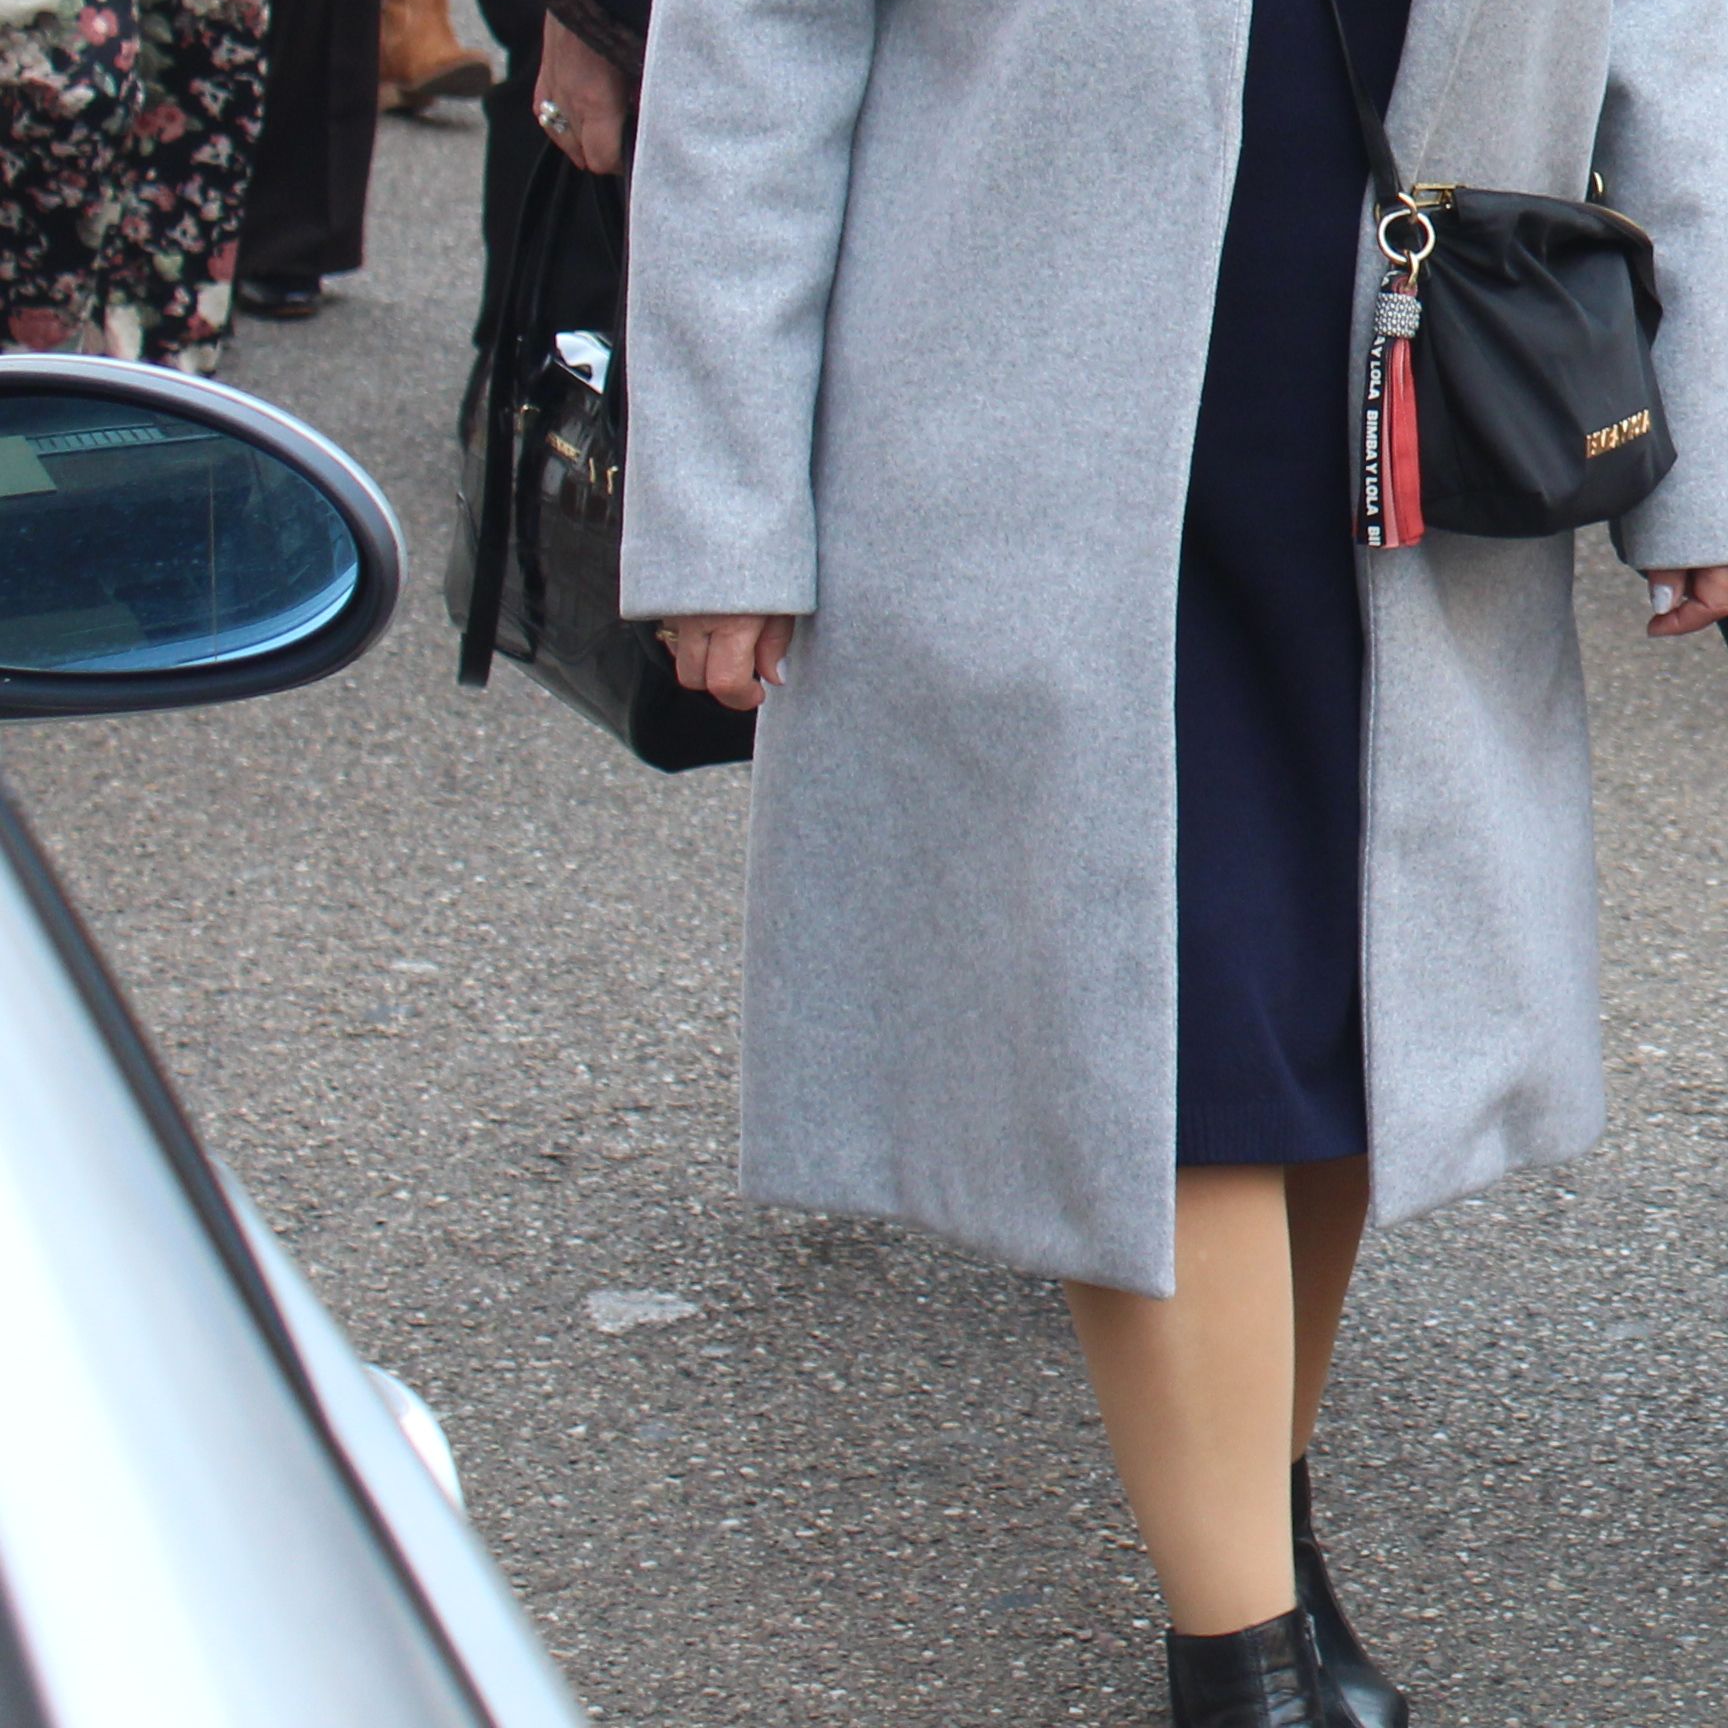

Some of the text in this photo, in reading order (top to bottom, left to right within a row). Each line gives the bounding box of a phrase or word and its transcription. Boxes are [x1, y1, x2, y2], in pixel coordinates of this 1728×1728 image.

[1368, 361, 1382, 399] LOLA
[1366, 410, 1379, 461] BIMBA
[1366, 462, 1378, 474] Y
[1366, 476, 1379, 516] LOLA
